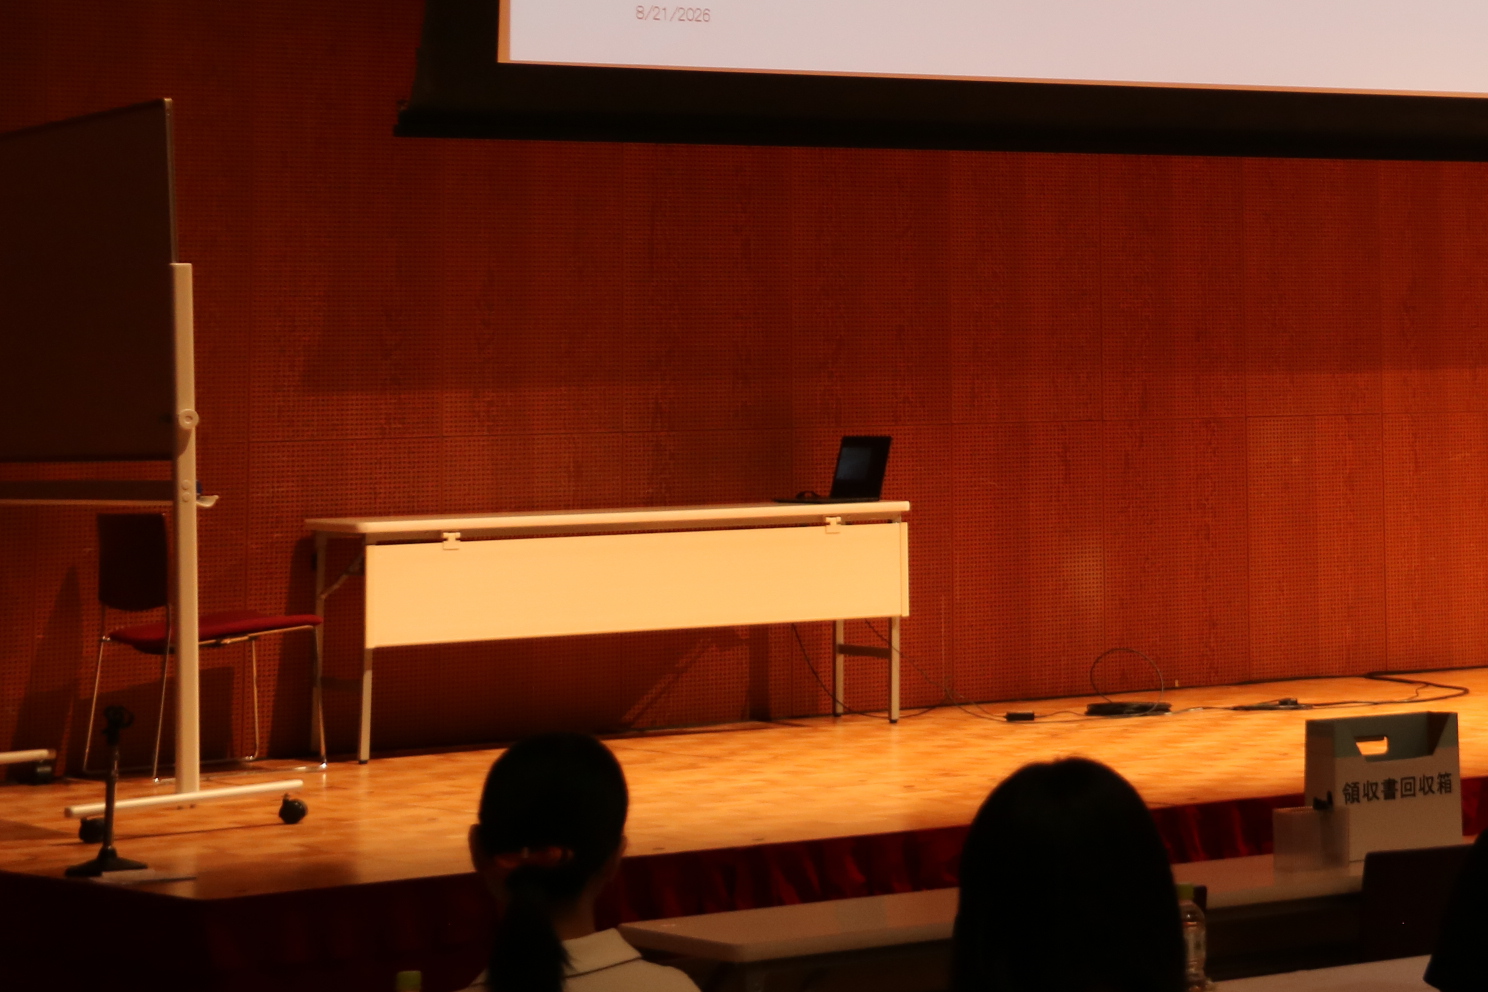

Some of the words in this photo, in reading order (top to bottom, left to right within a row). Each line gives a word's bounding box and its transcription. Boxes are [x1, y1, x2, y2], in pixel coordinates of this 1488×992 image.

[635, 4, 712, 23] 8/21/2026
[1342, 771, 1453, 805] 領収書回収箱
